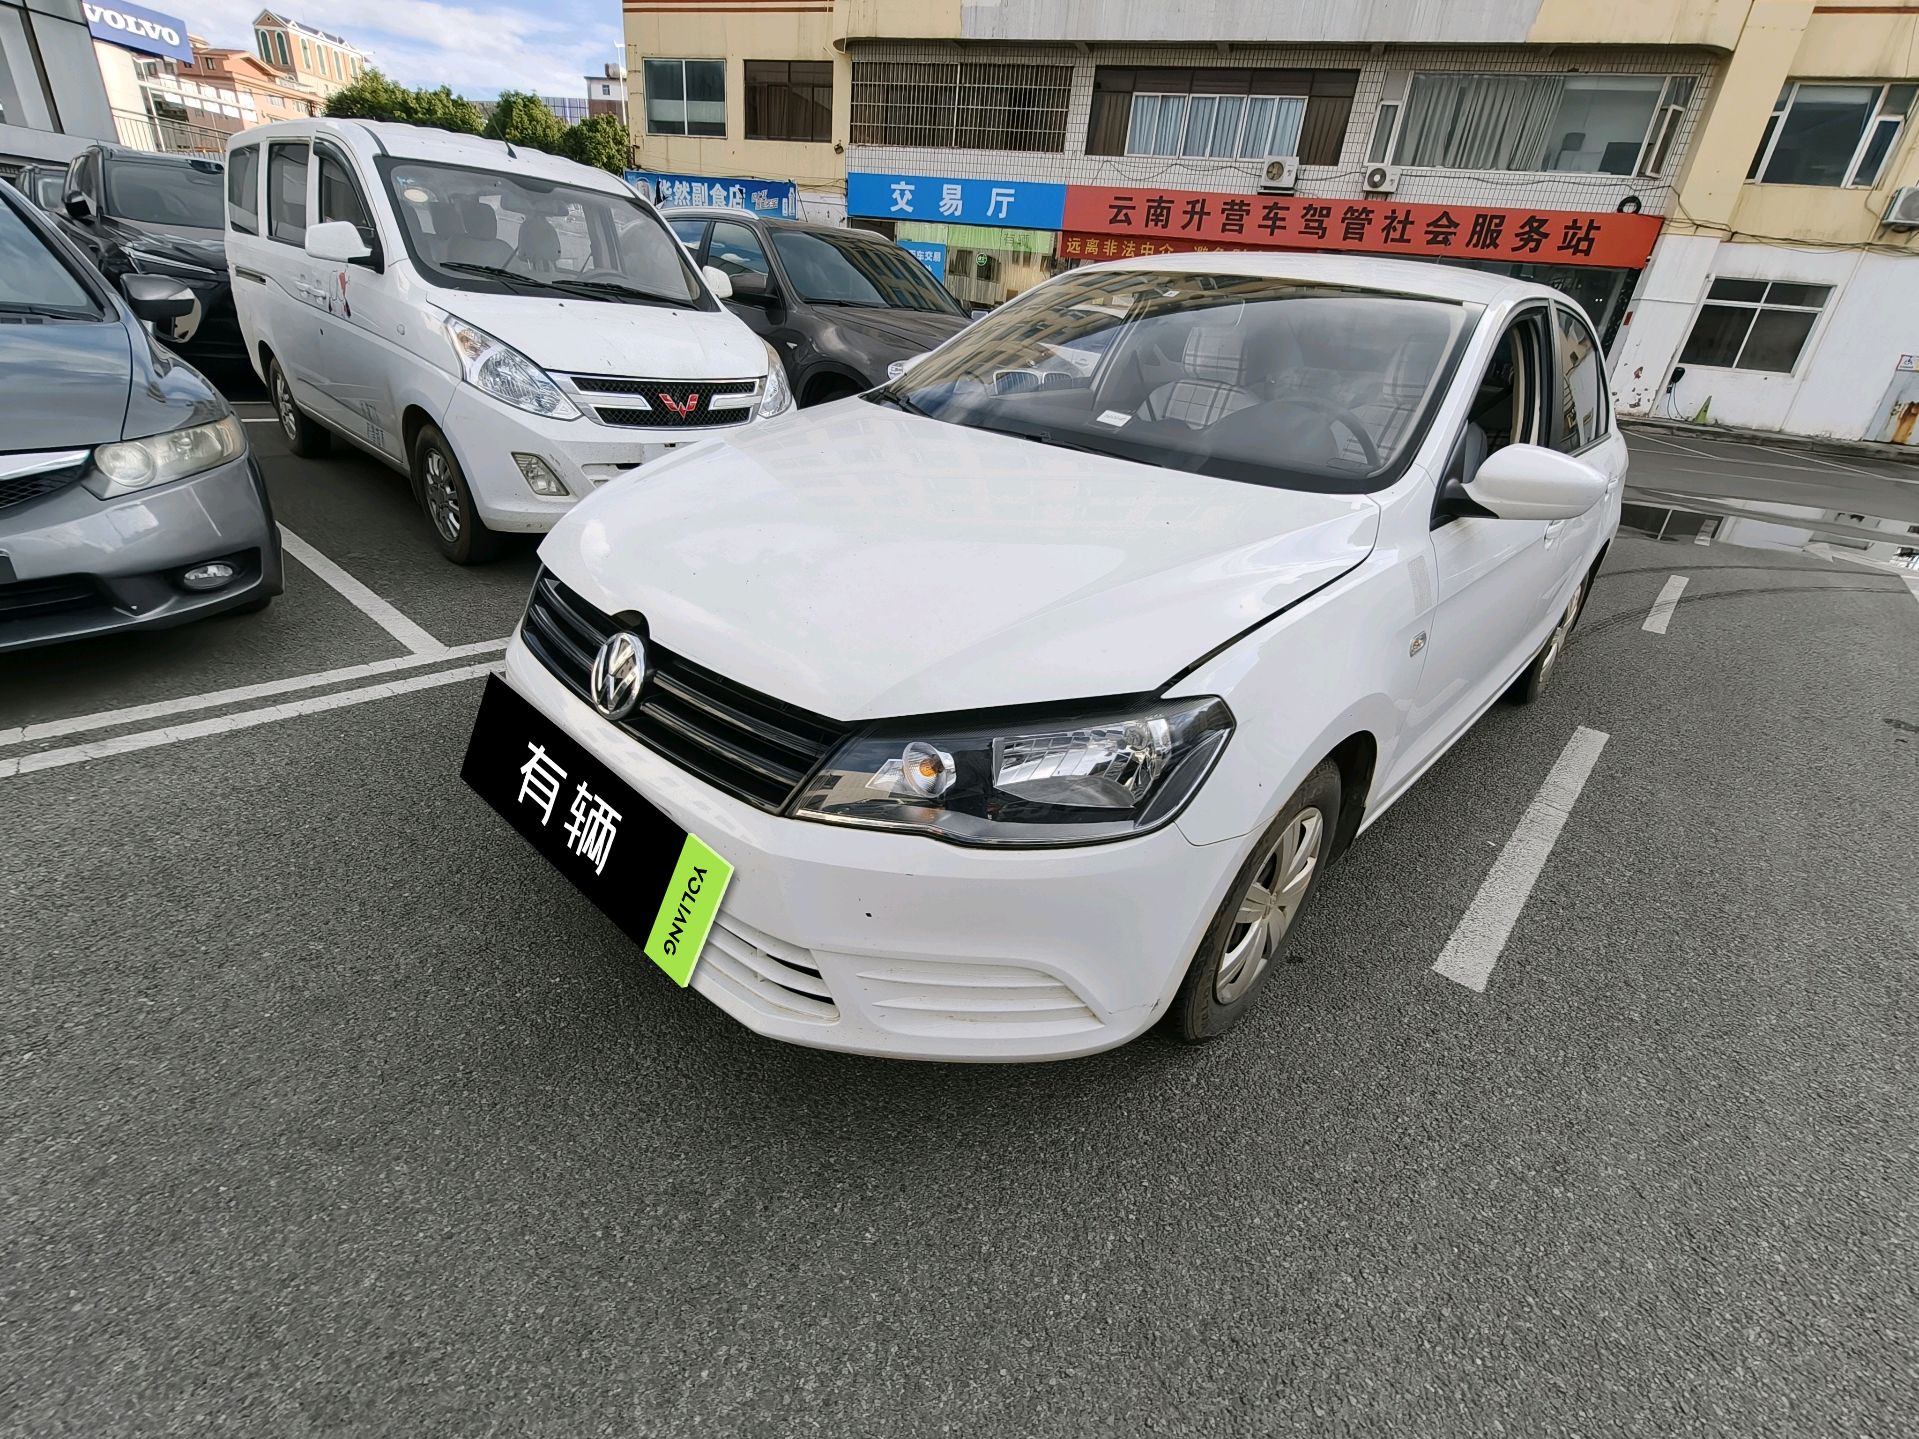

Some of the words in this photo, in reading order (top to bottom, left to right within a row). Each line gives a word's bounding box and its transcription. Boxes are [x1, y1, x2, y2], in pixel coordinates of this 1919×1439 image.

[82, 2, 180, 46] VOLVO
[889, 181, 1016, 218] 交易厅
[1108, 195, 1602, 257] 云南升营车驾管社会服务站
